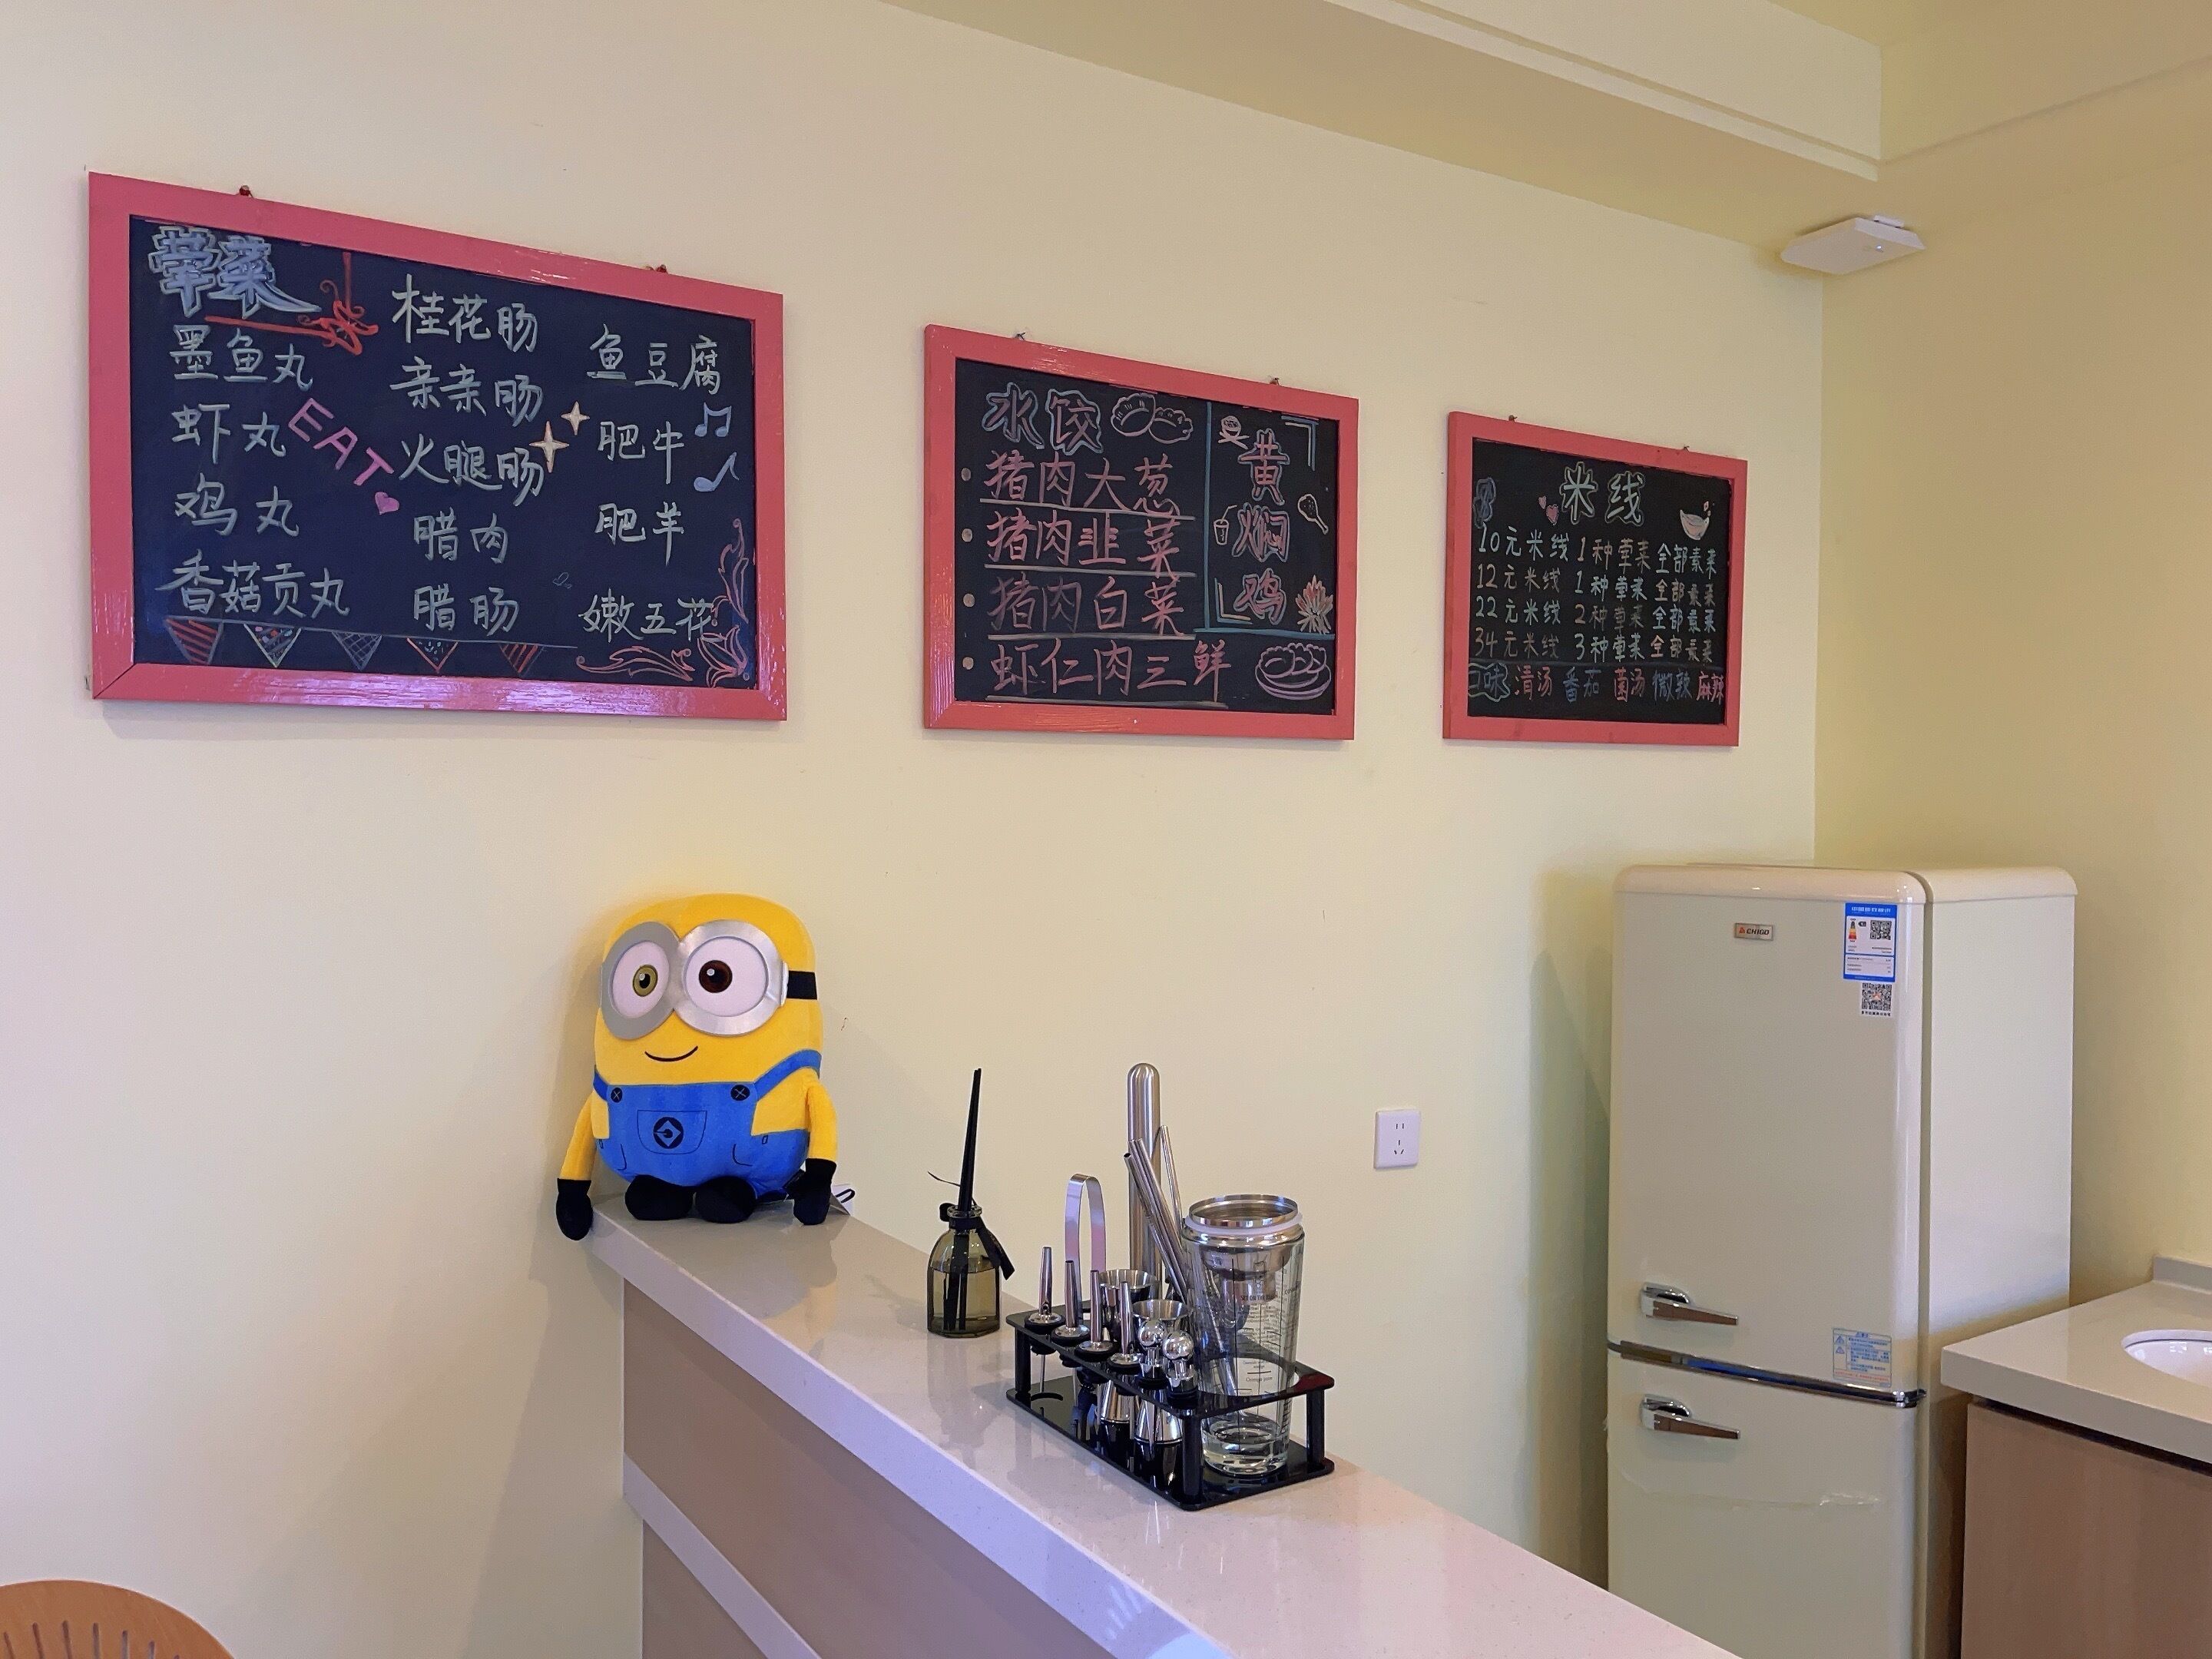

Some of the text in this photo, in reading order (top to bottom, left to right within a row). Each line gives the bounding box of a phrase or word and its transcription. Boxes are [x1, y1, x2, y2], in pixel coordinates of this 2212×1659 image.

[149, 226, 321, 319] 荤菜
[392, 273, 538, 353] 桂花肠
[169, 325, 313, 391] 墨鱼丸
[587, 323, 722, 395] 鱼豆腐
[390, 356, 544, 427] 亲亲肠
[982, 382, 1104, 455] 水饺
[171, 403, 286, 464] 虾丸
[288, 397, 394, 486] EAT
[598, 421, 685, 485] 肥牛
[399, 433, 544, 507] 火腿肠
[984, 449, 1180, 515] 猪肉大葱
[1559, 462, 1645, 526] 米线
[175, 472, 299, 537] 鸡丸
[413, 507, 508, 565] 腊肉
[594, 502, 685, 566] 肥羊
[1232, 428, 1290, 624] 黄焖鸡
[986, 508, 1181, 580] 猪肉韭菜
[1479, 522, 1717, 579] 10元米线 1种荤菜 全部素菜
[154, 549, 349, 619] 香菇贡丸
[413, 583, 519, 637] 腊肠
[988, 571, 1184, 637] 猪肉白菜
[1475, 595, 1561, 625] 22元米线
[1476, 563, 1560, 593] 12元米线
[1575, 570, 1647, 601] 1种荤菜
[578, 588, 714, 643] 嫩五花
[1475, 627, 1559, 659] 34元米线
[990, 638, 1230, 702] 虾仁肉三鲜
[1469, 663, 1510, 700] 口味
[1515, 664, 1552, 700] 清汤
[1562, 667, 1601, 703] 番茄
[1614, 667, 1645, 702] 菌汤
[1696, 671, 1724, 705] 麻辣
